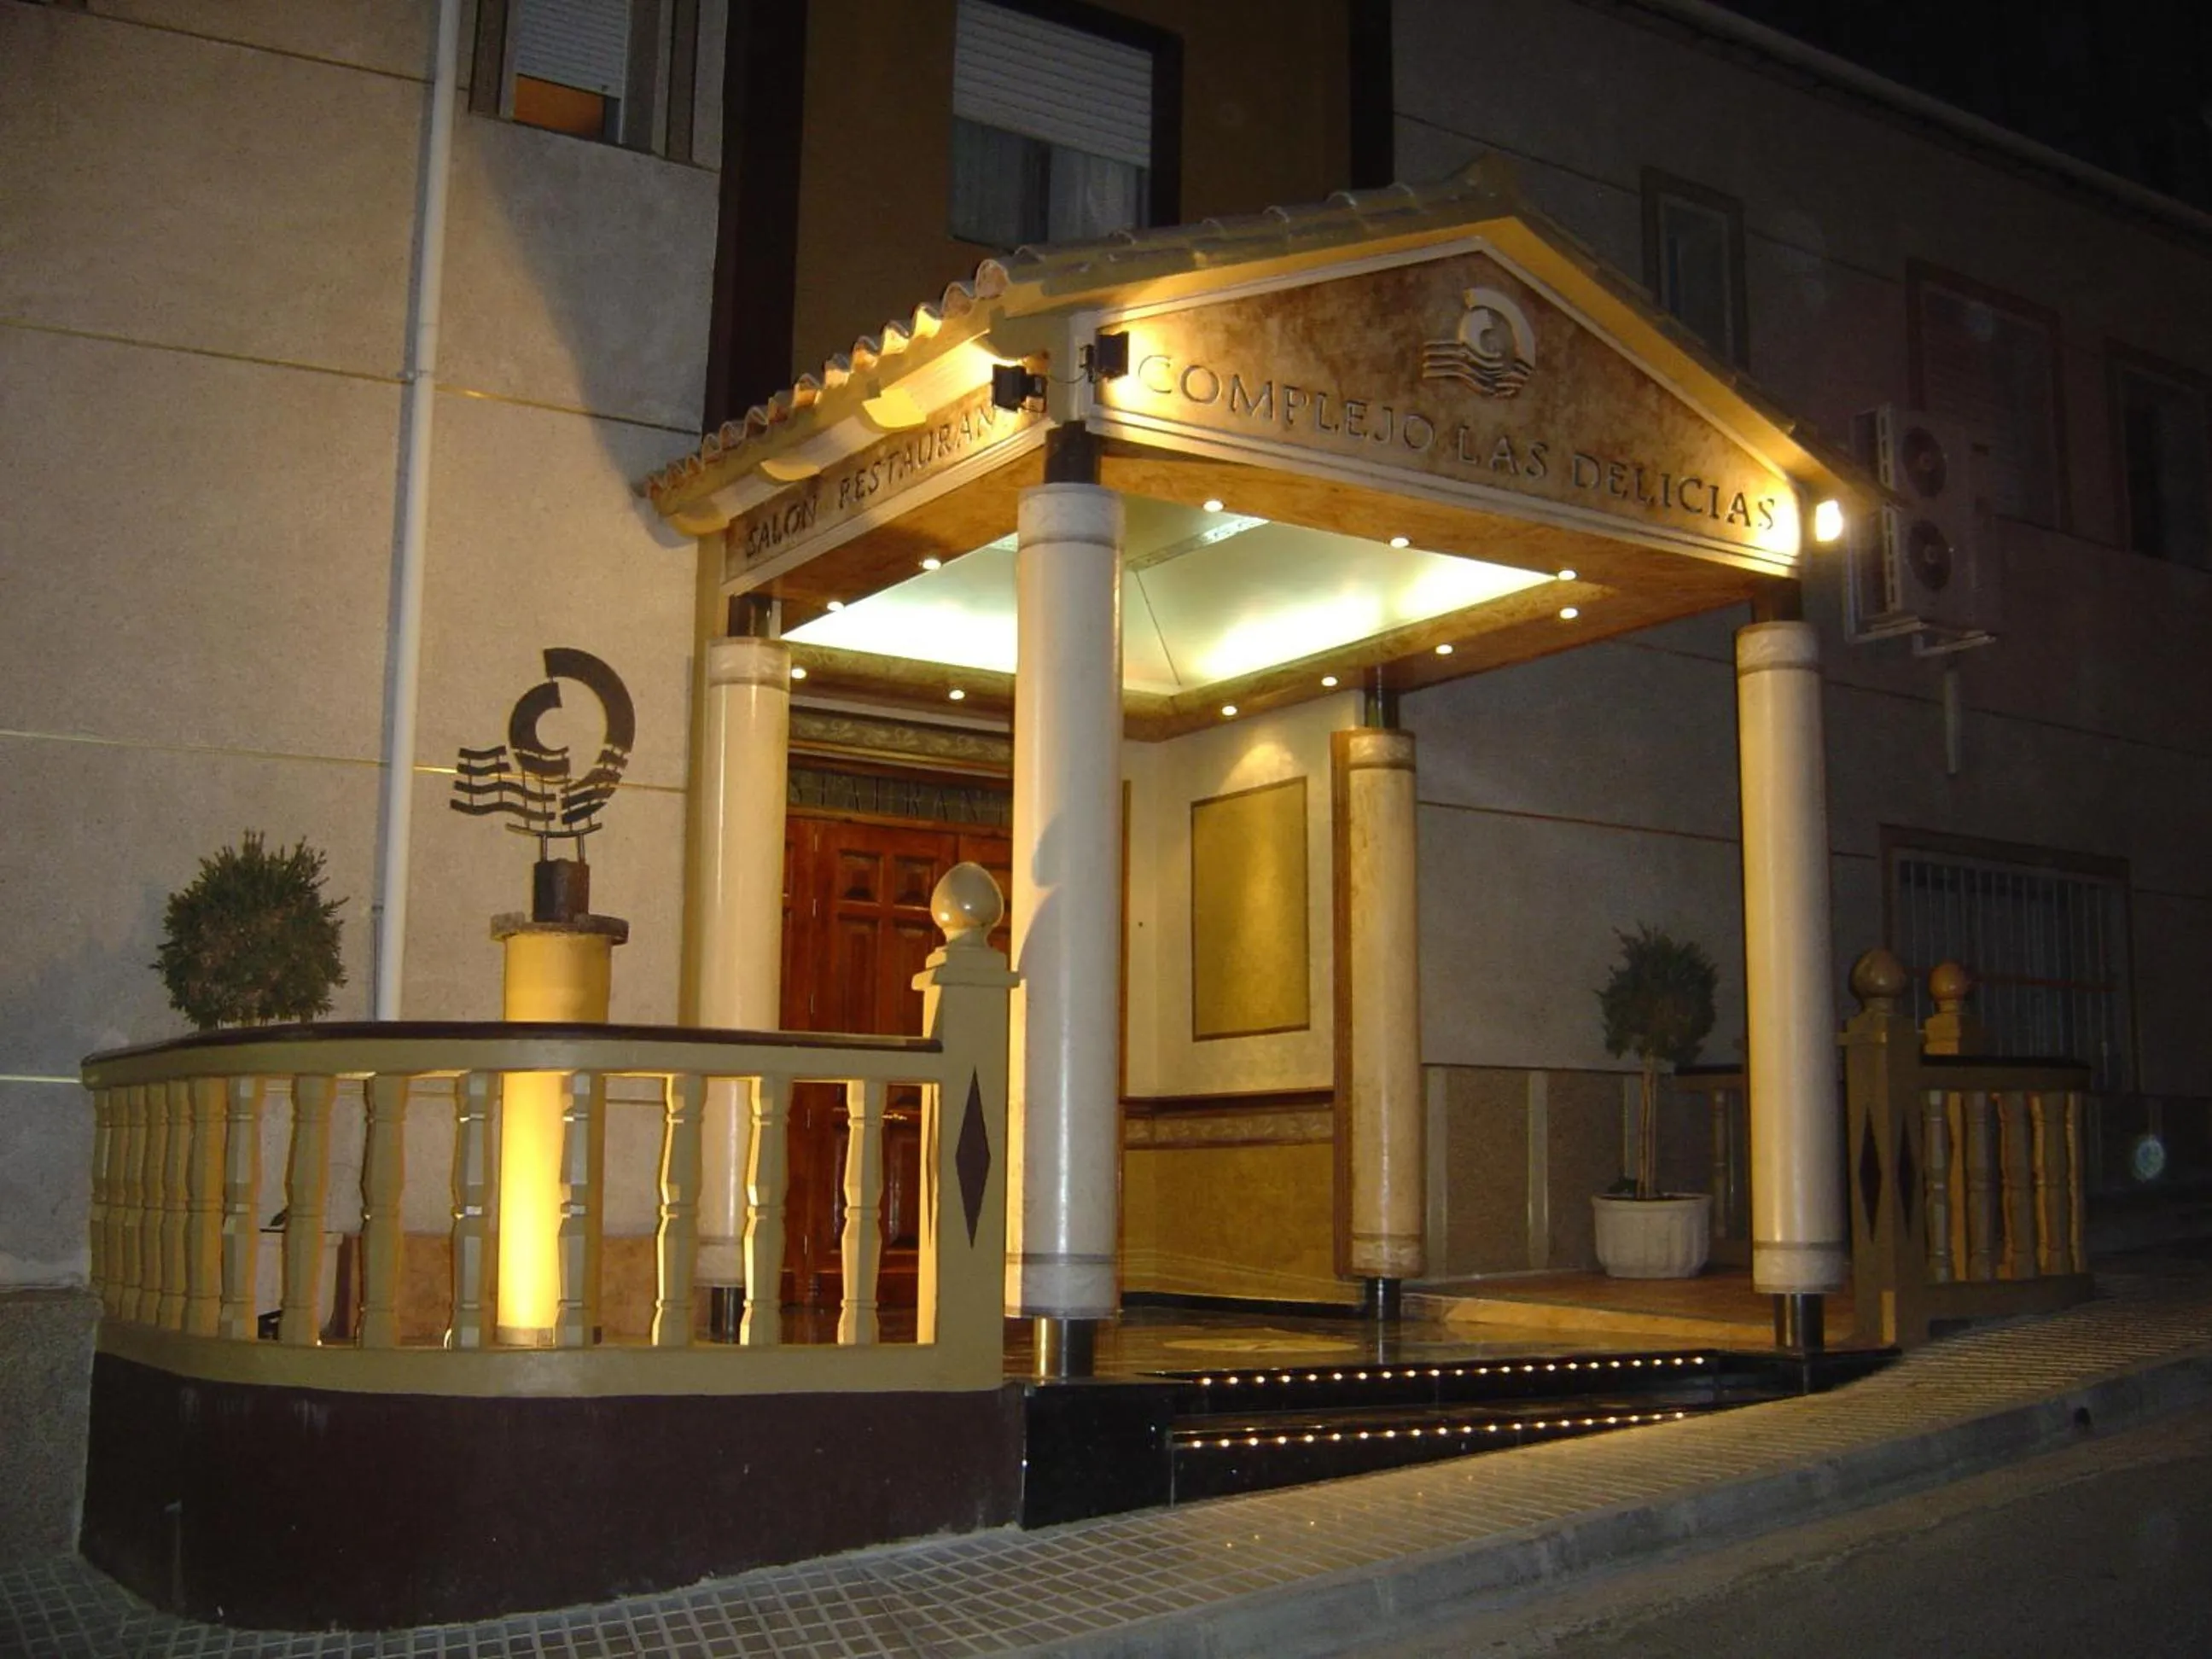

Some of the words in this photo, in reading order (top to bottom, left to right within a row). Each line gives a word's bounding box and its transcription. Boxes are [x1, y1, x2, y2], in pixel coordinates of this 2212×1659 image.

[1138, 354, 1436, 453] COMPLEJO
[1456, 426, 1549, 480] LAS
[1572, 451, 1776, 530] DELICIAS
